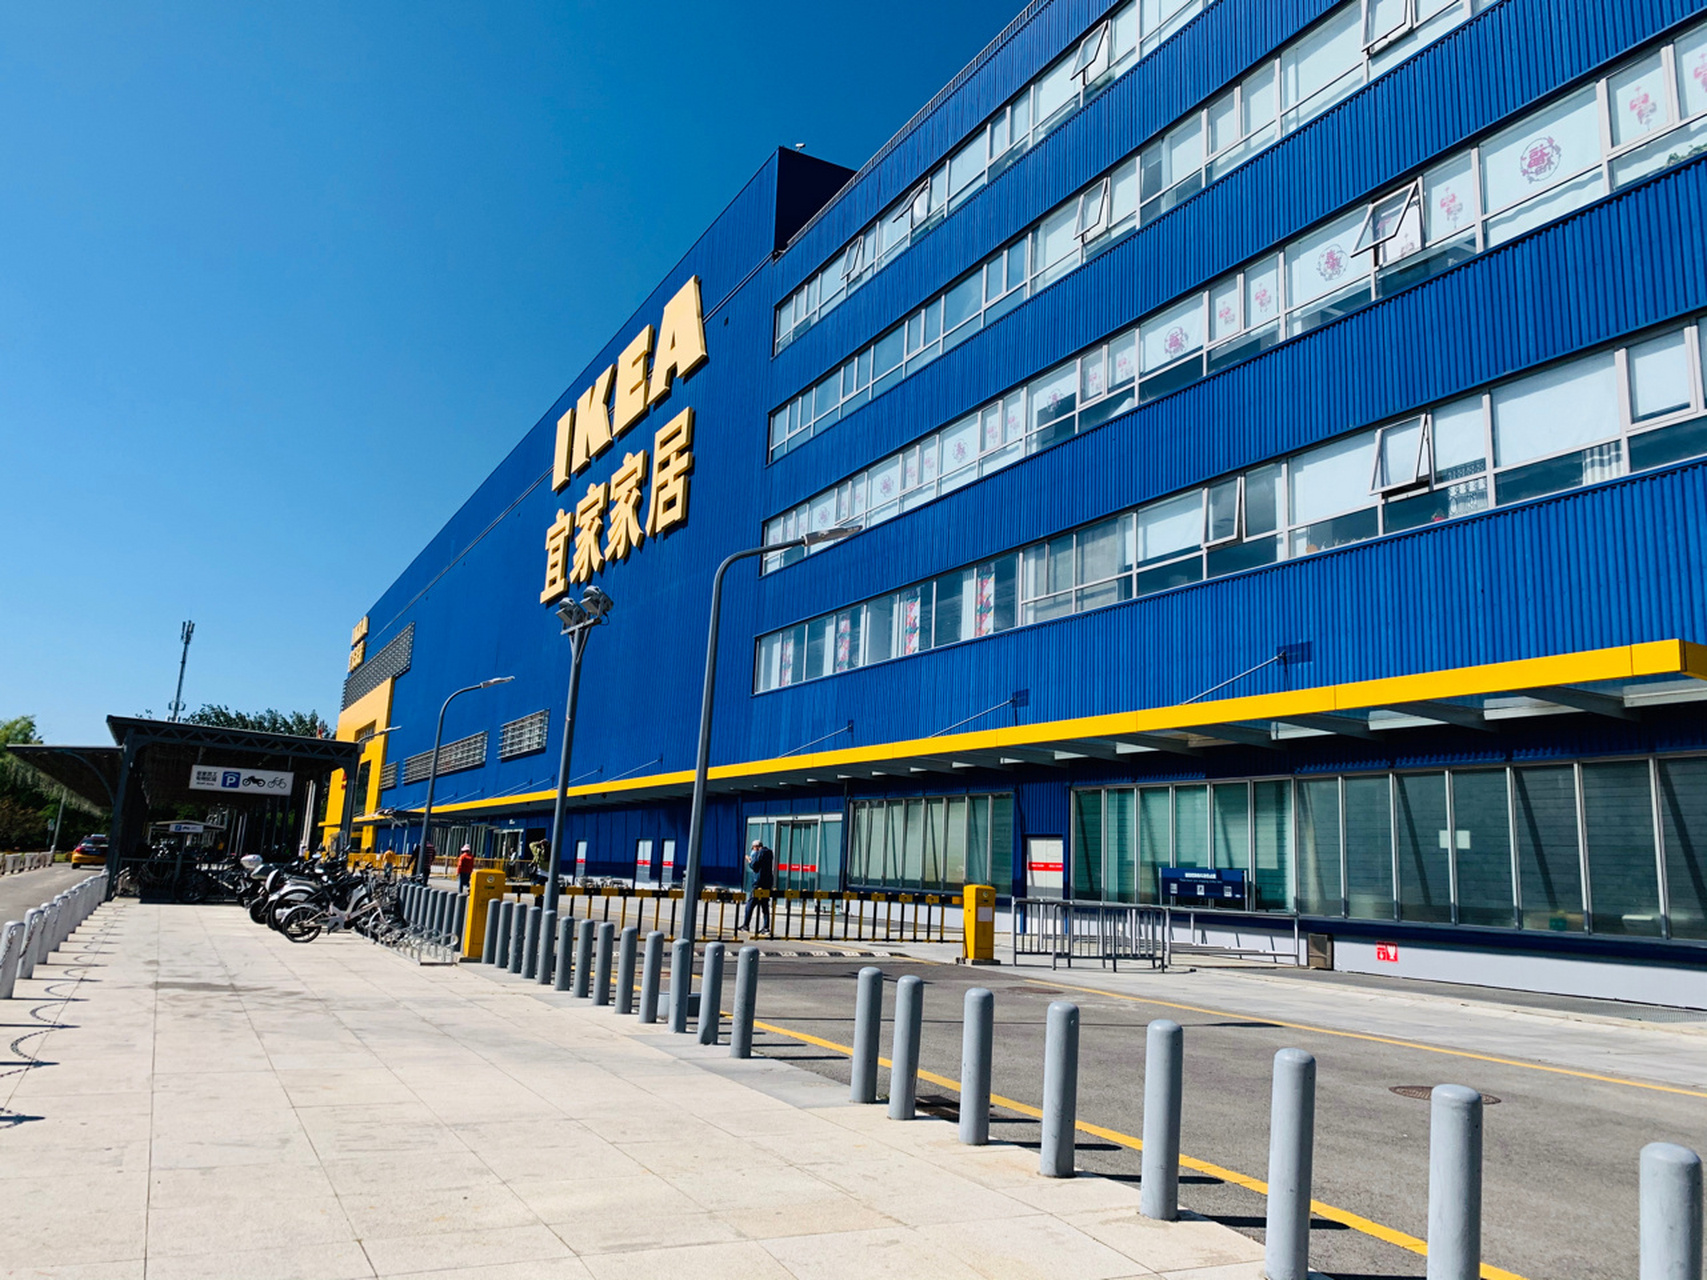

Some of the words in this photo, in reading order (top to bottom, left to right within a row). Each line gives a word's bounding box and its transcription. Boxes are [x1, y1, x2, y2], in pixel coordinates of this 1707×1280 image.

[552, 275, 707, 491] IKEA
[540, 406, 694, 604] 宜家家居
[226, 776, 236, 786] P
